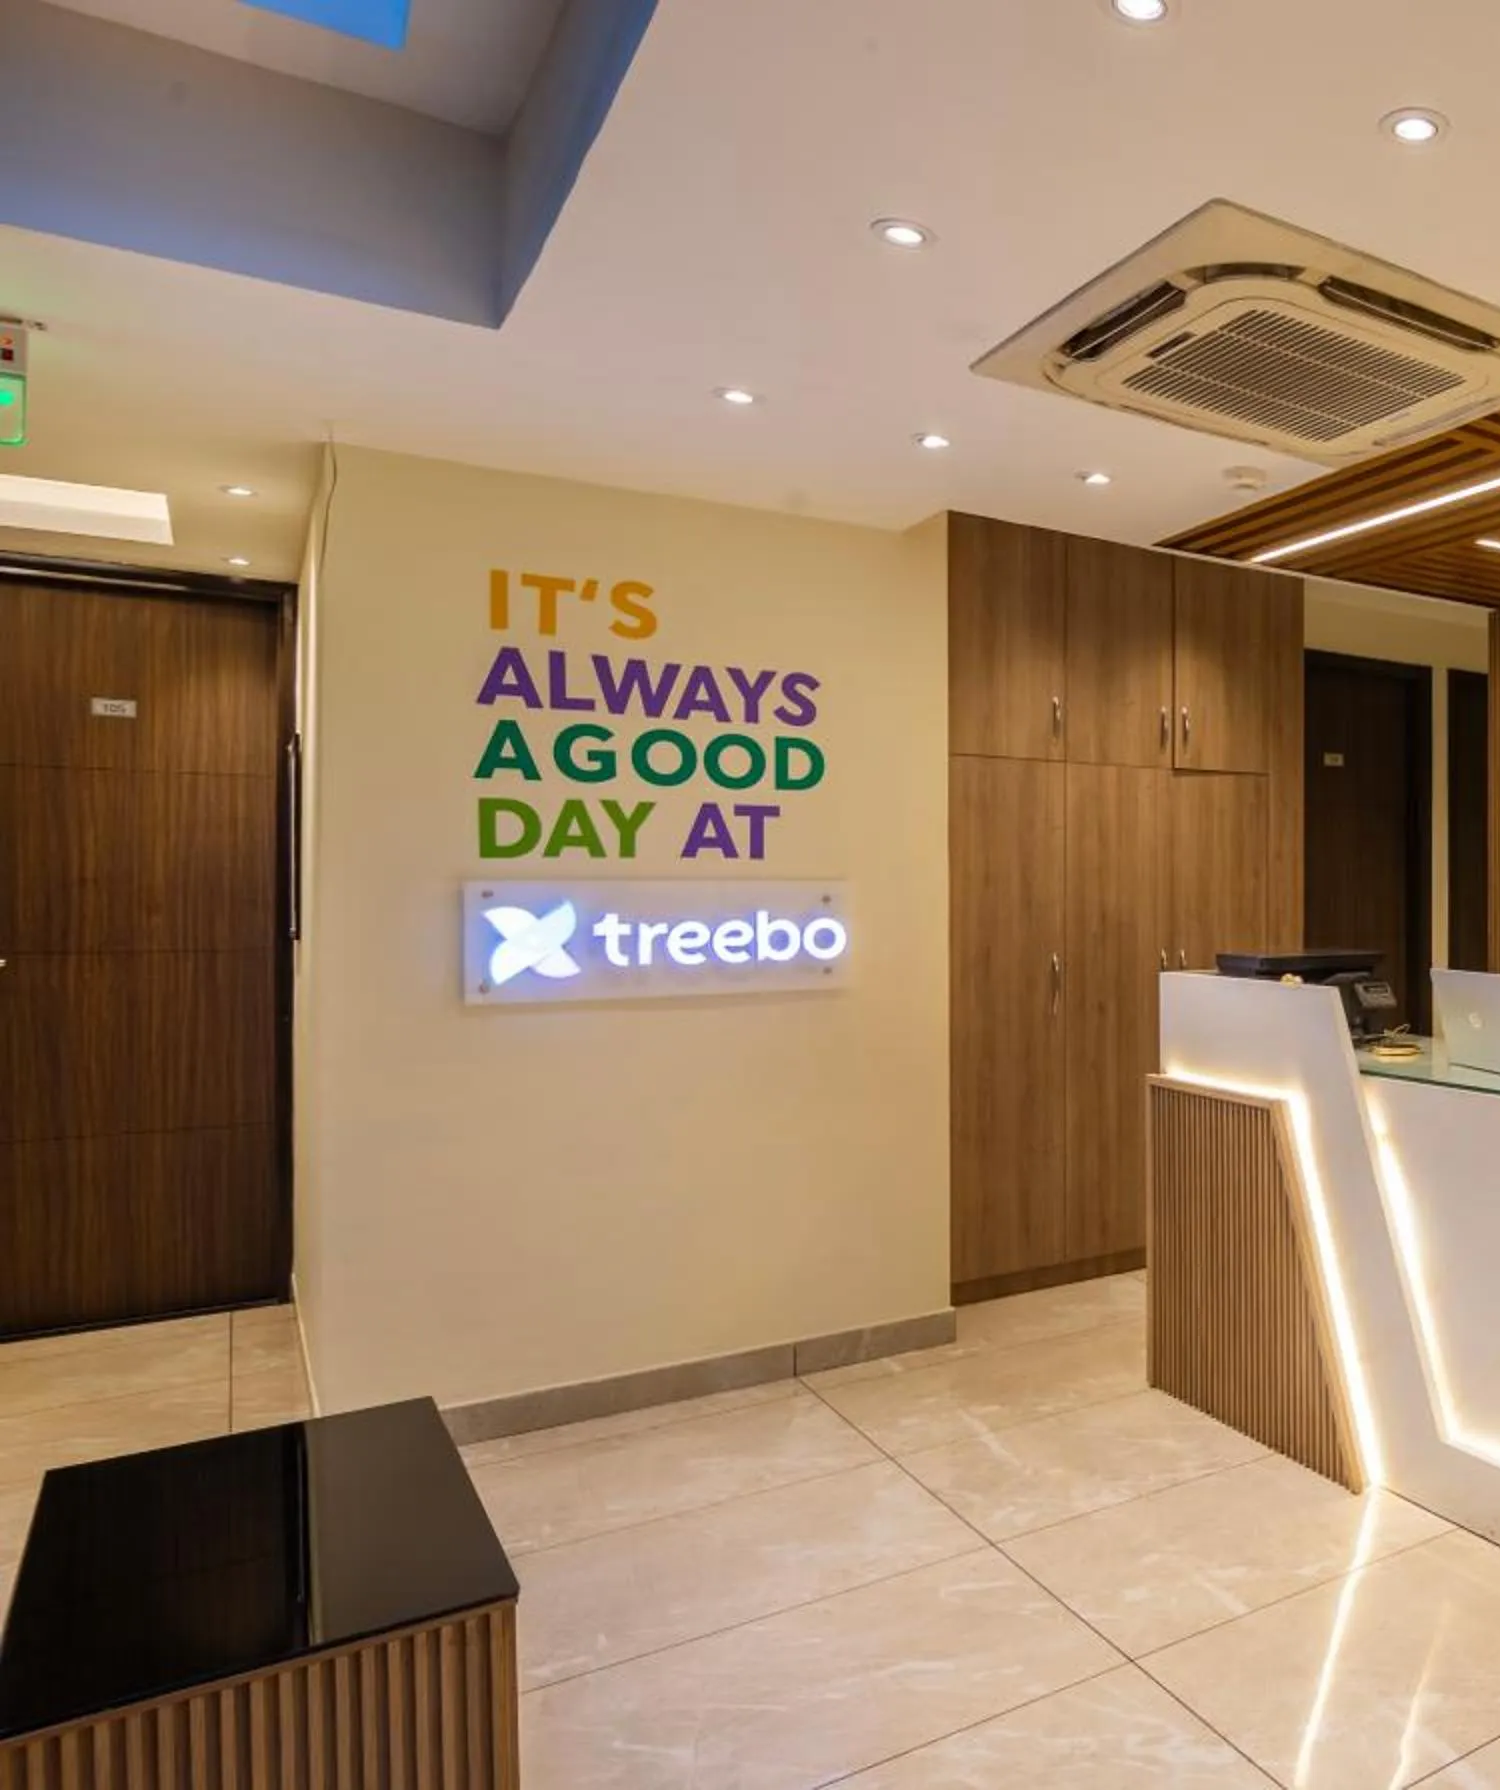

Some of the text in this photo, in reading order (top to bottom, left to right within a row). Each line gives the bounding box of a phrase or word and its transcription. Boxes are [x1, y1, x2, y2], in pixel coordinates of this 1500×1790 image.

[490, 569, 657, 640] IT'S
[476, 647, 821, 727] ALWAYS
[478, 797, 781, 861] DAY AT
[592, 909, 847, 967] treebo
